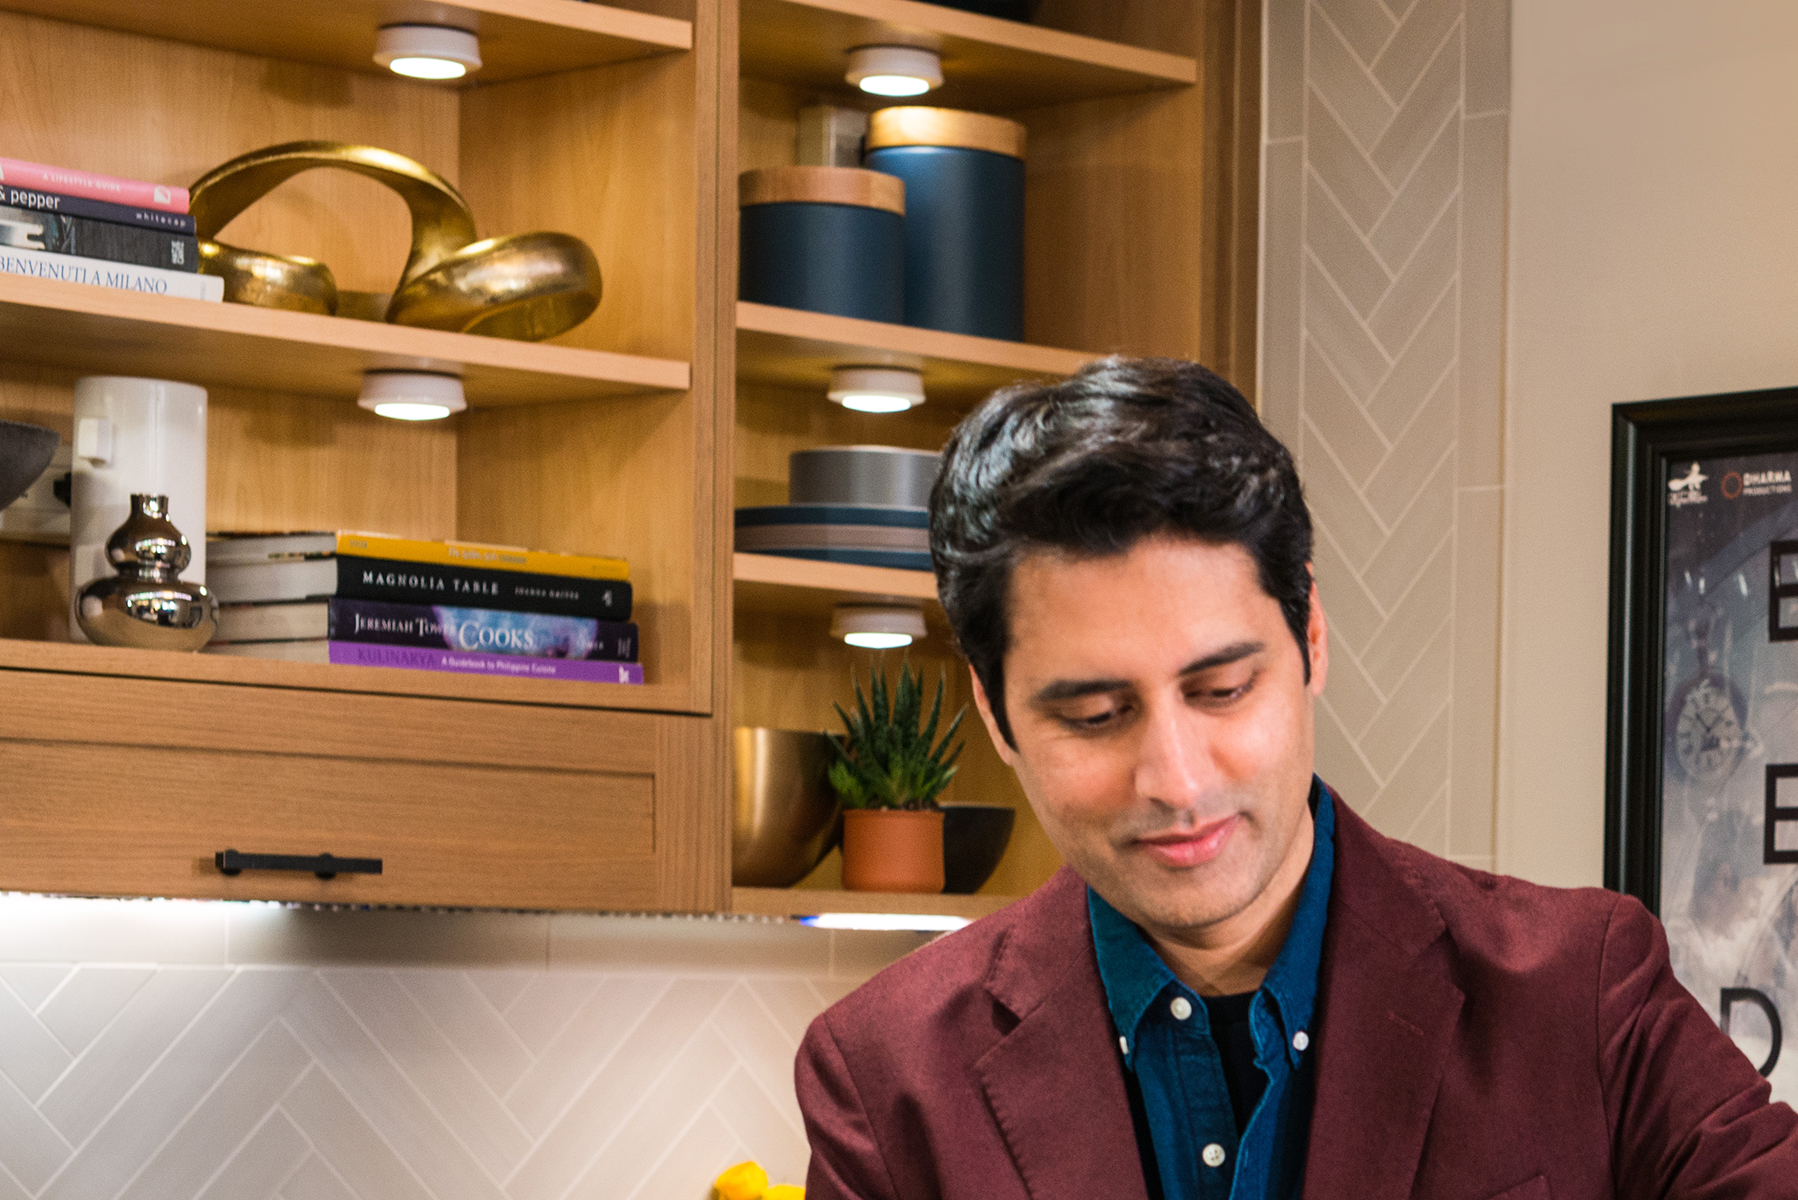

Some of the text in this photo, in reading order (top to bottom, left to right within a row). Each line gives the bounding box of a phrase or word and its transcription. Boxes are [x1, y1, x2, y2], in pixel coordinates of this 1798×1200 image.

[10, 189, 61, 210] pepper
[0, 256, 168, 295] BENVENUTI A MILANO
[362, 570, 500, 596] MAGNOLIA TABLE
[354, 613, 414, 635] JEREMIAH
[458, 620, 534, 650] COOKS
